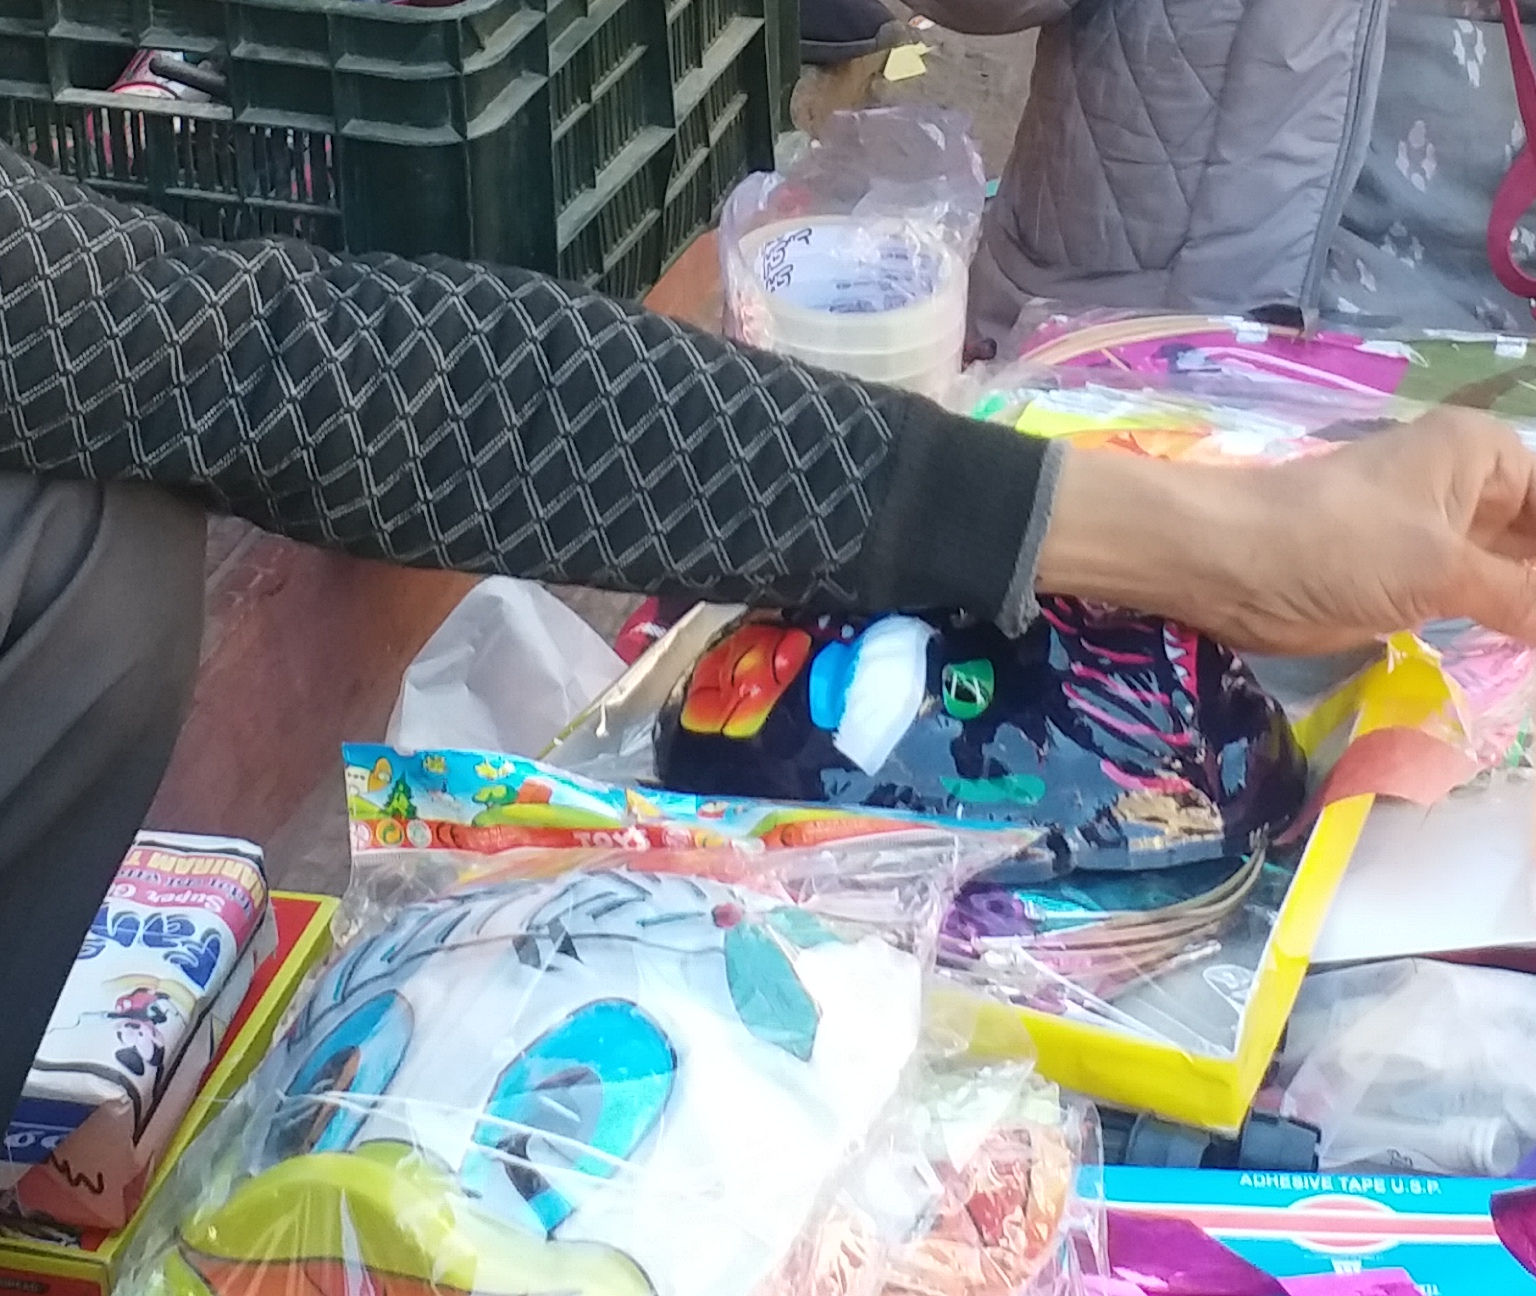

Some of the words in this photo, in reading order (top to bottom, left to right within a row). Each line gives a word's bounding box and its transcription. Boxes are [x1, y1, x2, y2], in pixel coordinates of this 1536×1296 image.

[146, 888, 227, 913] Super
[1239, 1173, 1334, 1191] ADHESIVE
[1338, 1176, 1386, 1194] TAPE
